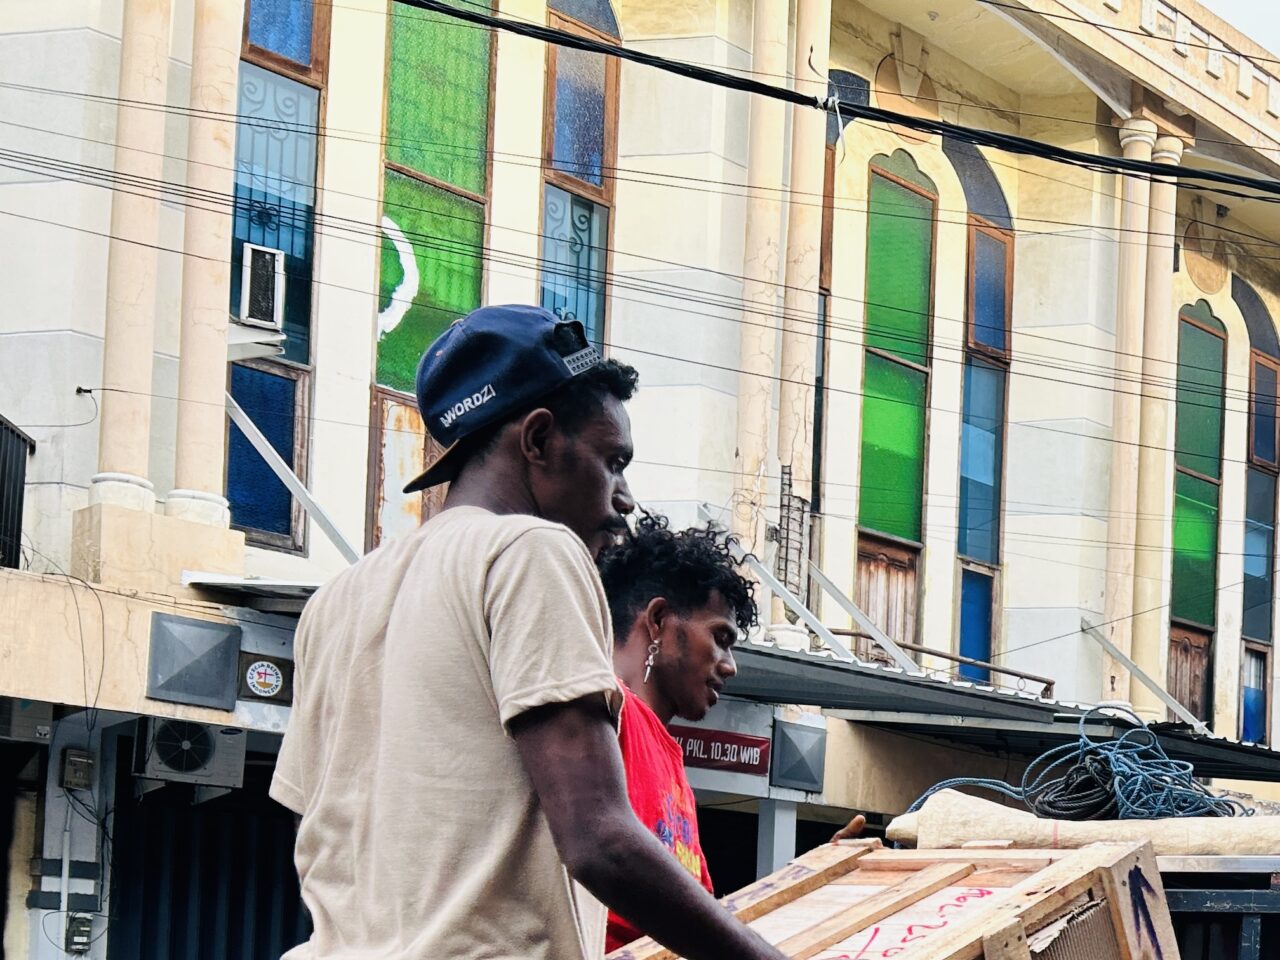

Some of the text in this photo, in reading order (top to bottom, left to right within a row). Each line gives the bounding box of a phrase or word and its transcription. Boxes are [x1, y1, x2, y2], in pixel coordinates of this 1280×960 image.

[686, 739, 708, 759] PKL.
[710, 742, 738, 762] 10.30
[740, 745, 761, 765] WIB
